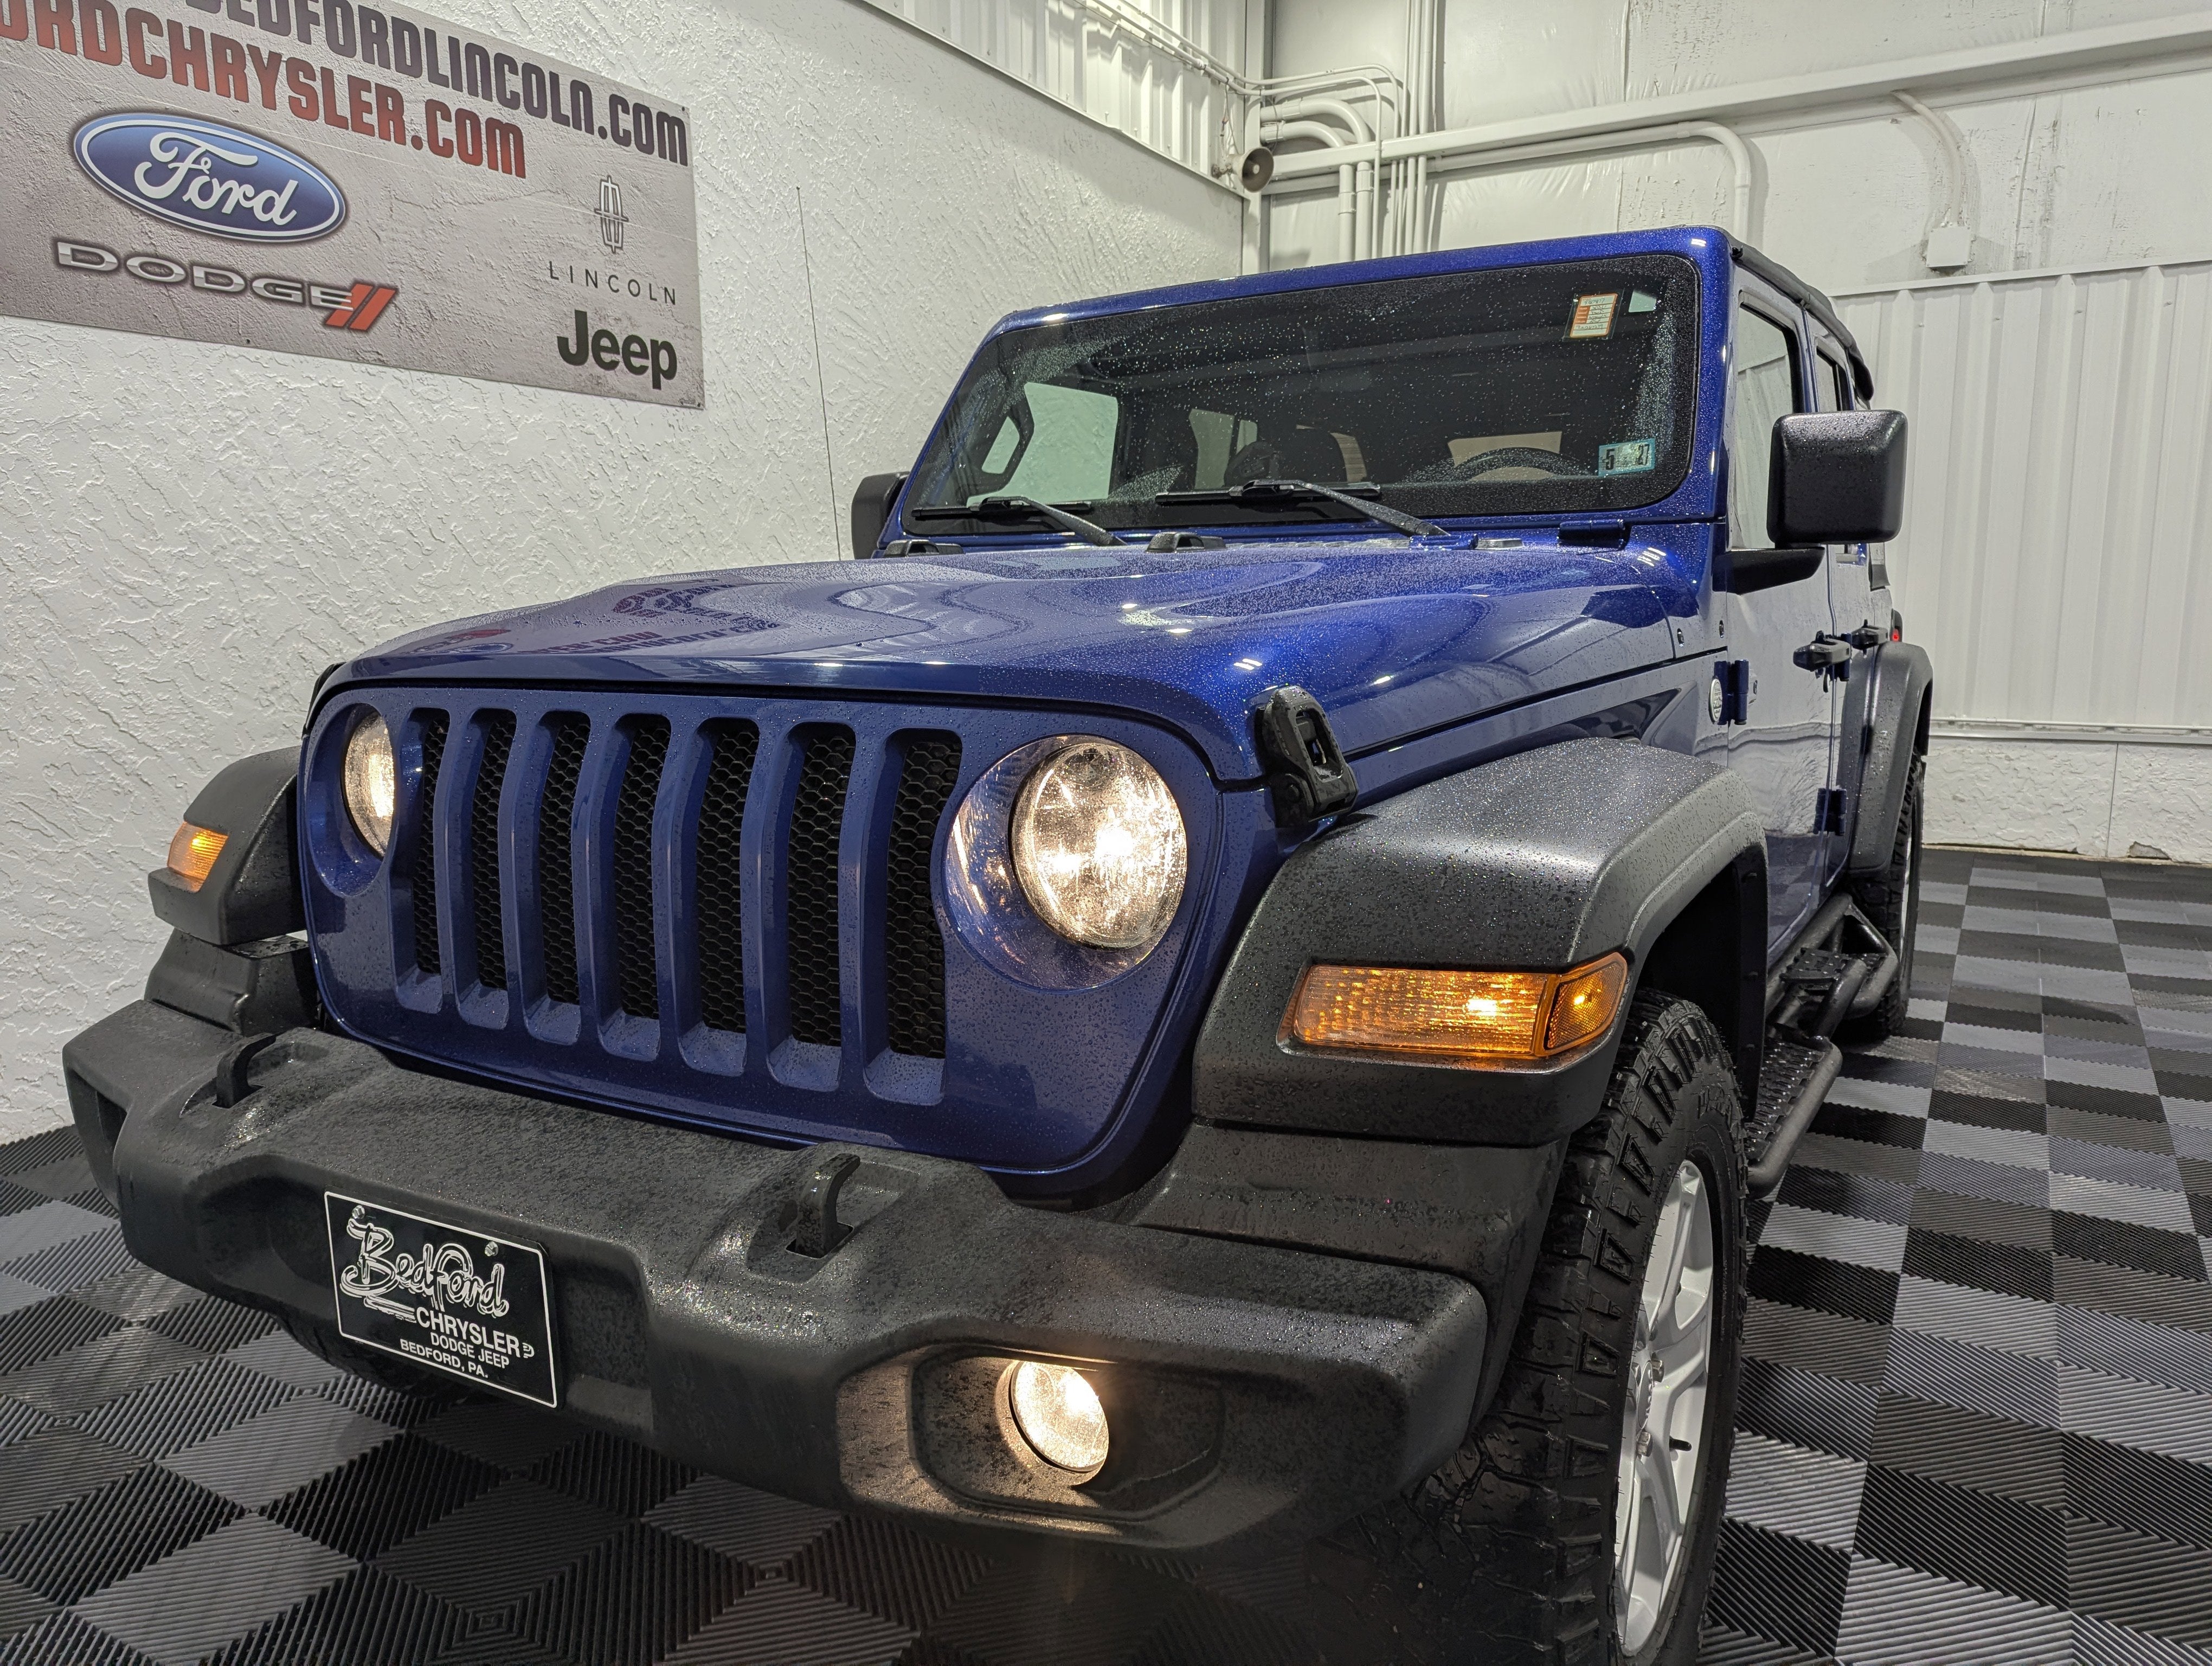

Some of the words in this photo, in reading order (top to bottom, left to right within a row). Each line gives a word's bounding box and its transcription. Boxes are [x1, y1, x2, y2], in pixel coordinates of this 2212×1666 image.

[185, 0, 688, 166] DFORDLINCOLN.COM
[134, 132, 298, 226] Ford
[57, 241, 354, 312] DODGE
[549, 261, 676, 305] LINCOLN
[557, 309, 678, 390] Jeep
[1605, 448, 1615, 470] 5
[340, 1218, 510, 1318] Bedford
[400, 1338, 465, 1372] BEDFORD,
[468, 1361, 488, 1379] PA.
[416, 1307, 520, 1358] CHRYSLER
[430, 1332, 475, 1359] DODGE
[478, 1349, 510, 1369] JEEP
